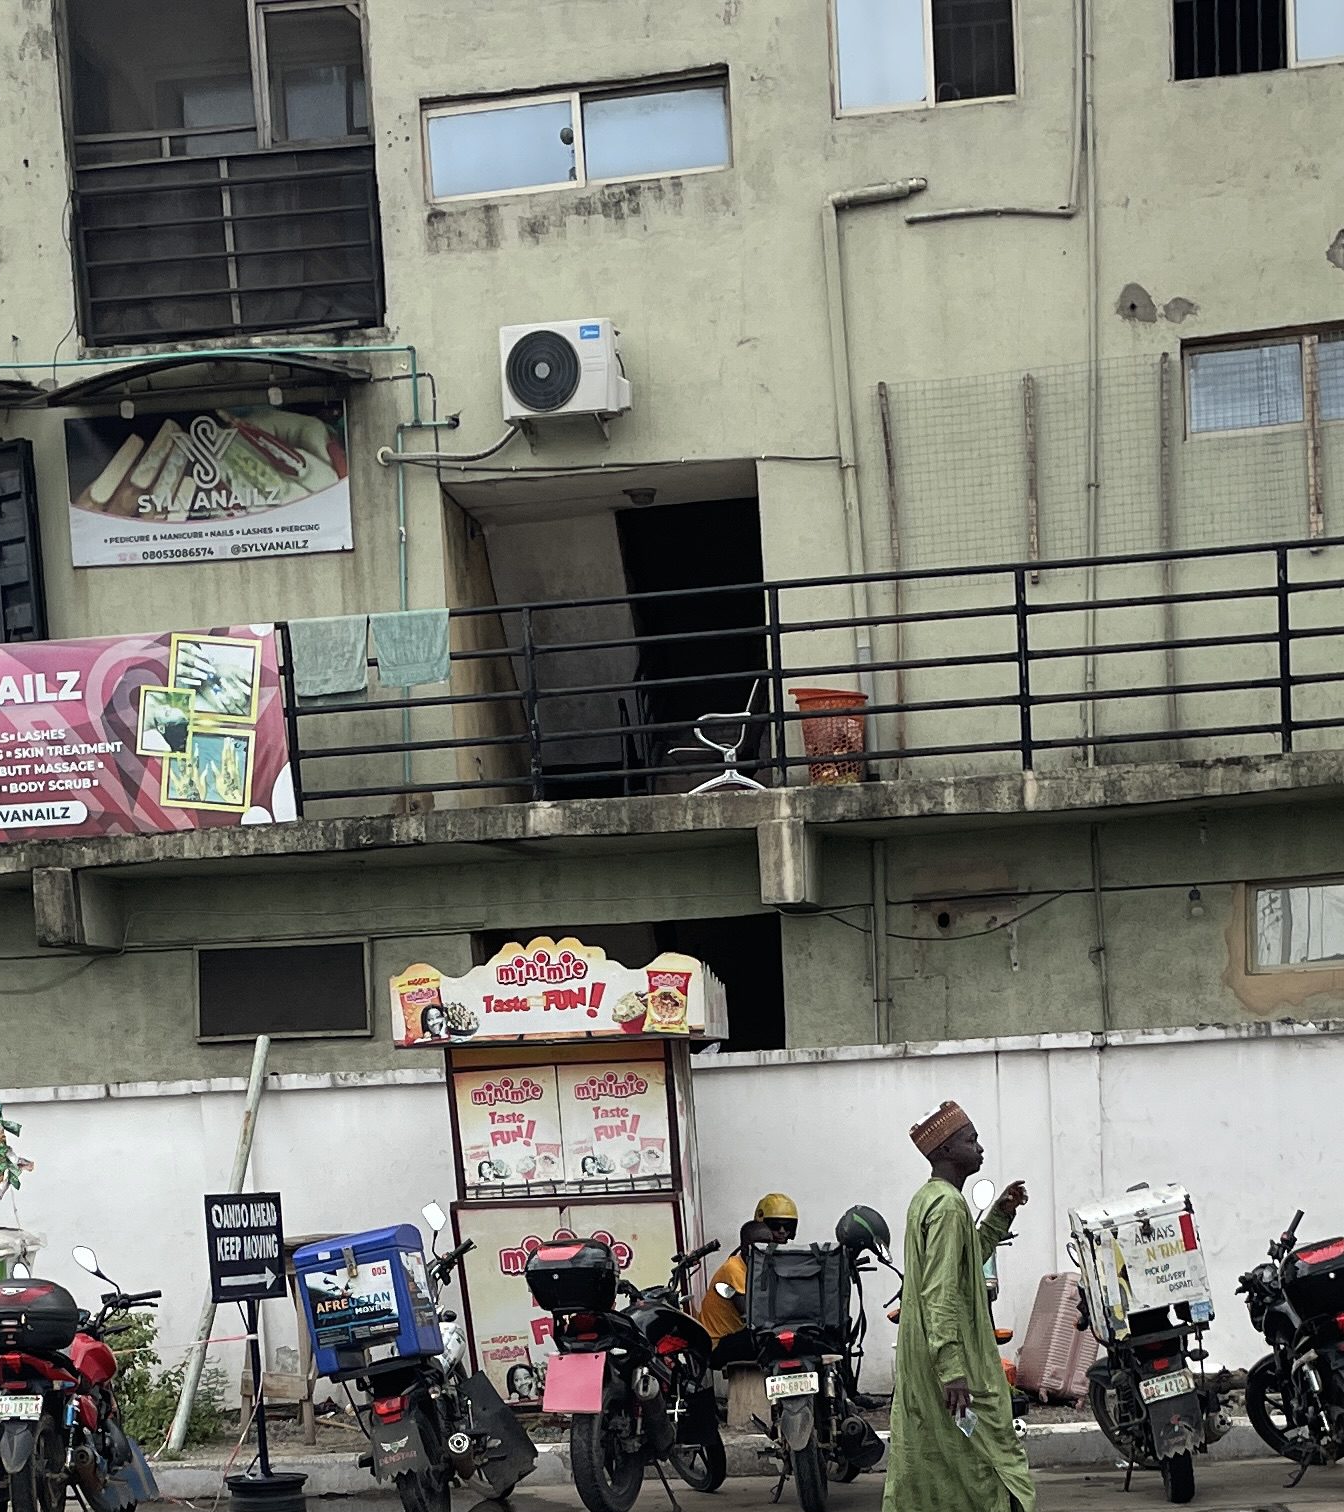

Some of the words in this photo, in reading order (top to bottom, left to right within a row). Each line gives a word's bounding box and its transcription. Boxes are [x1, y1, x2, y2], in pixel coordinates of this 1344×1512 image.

[138, 488, 280, 513] SYLVANAILZ
[109, 534, 150, 544] PEDICURE
[160, 531, 203, 541] MANICURE
[209, 529, 234, 538] NAILS
[241, 526, 273, 536] LASHES
[280, 523, 320, 533] PIERCING
[142, 547, 214, 560] 08053086574
[17, 729, 66, 742] LASHES
[14, 747, 44, 760] SKIN
[47, 741, 123, 756] TREATMENT
[0, 764, 30, 777] BUTT
[34, 760, 95, 775] MASSAGE
[9, 781, 45, 794] BODY
[48, 778, 91, 791] SCRUB
[497, 951, 588, 986] minimie
[482, 994, 532, 1014] Taste
[542, 982, 606, 1019] FUN!
[471, 1077, 544, 1106] minimie
[575, 1072, 649, 1101] minimie
[488, 1111, 525, 1125] Taste
[592, 1105, 629, 1120] Taste
[490, 1120, 537, 1147] FUN!
[593, 1114, 641, 1142] FUN!
[211, 1203, 249, 1229] OANDO
[250, 1202, 278, 1227] AHEAD
[217, 1236, 242, 1262] KEEP
[243, 1233, 279, 1260] MOVING
[371, 1265, 387, 1277] 005
[1156, 1269, 1187, 1285] DELIVERY
